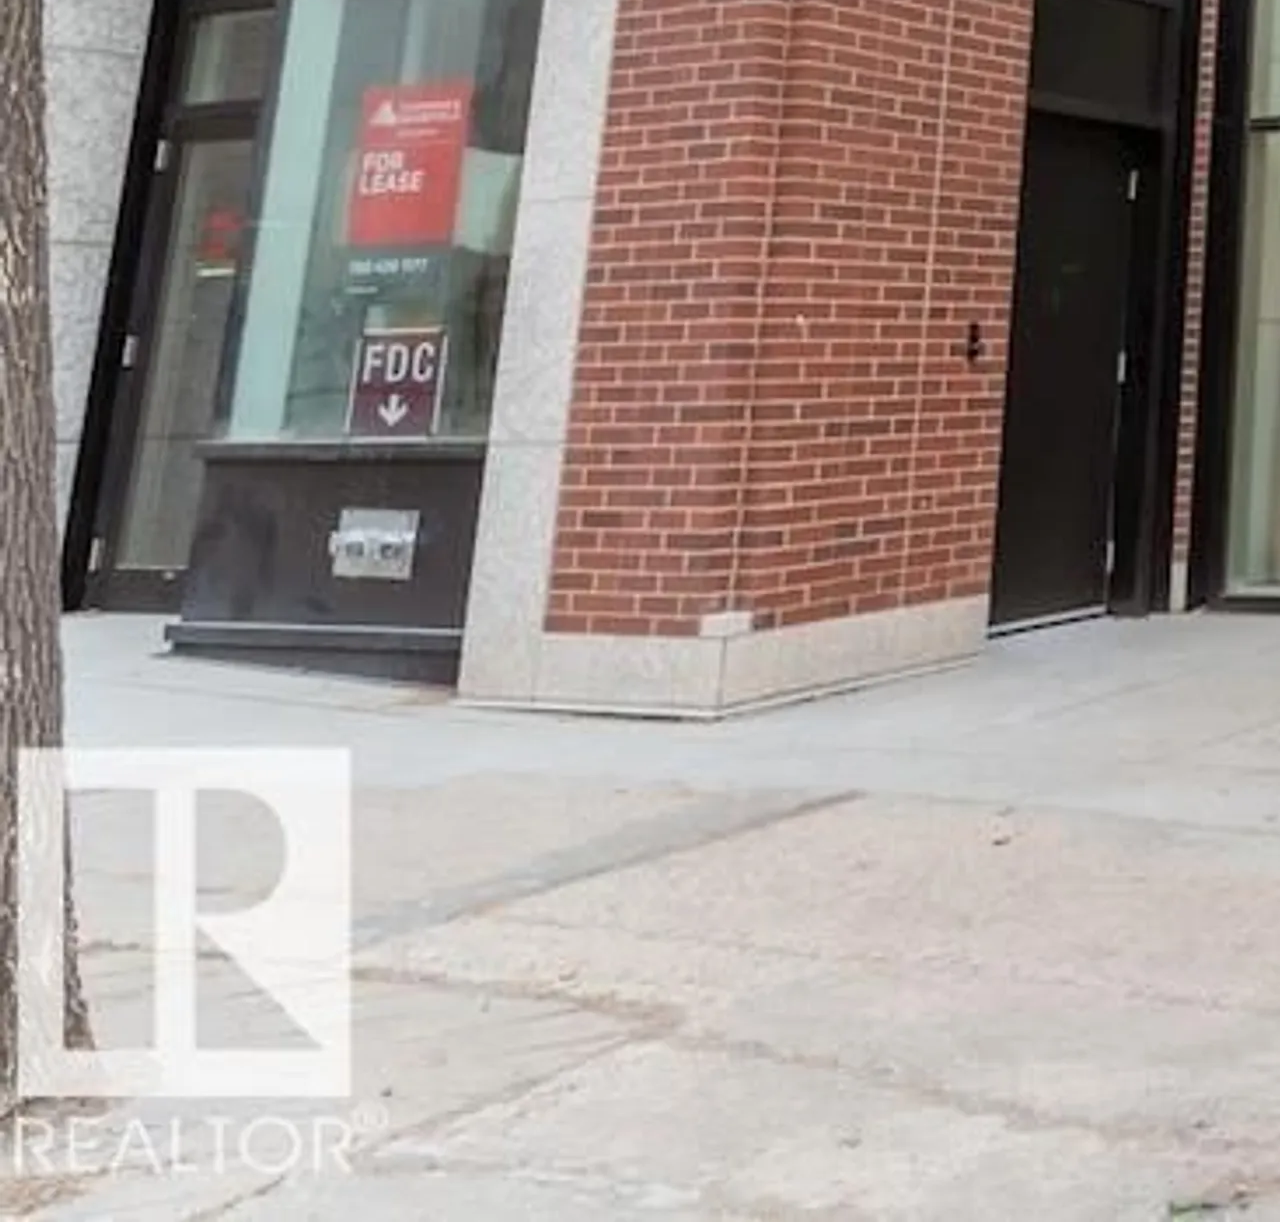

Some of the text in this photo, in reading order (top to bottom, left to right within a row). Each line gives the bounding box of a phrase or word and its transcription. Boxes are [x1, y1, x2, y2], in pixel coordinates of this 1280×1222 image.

[362, 151, 404, 171] FOR
[359, 169, 426, 194] LEASE
[363, 342, 434, 383] FDC
